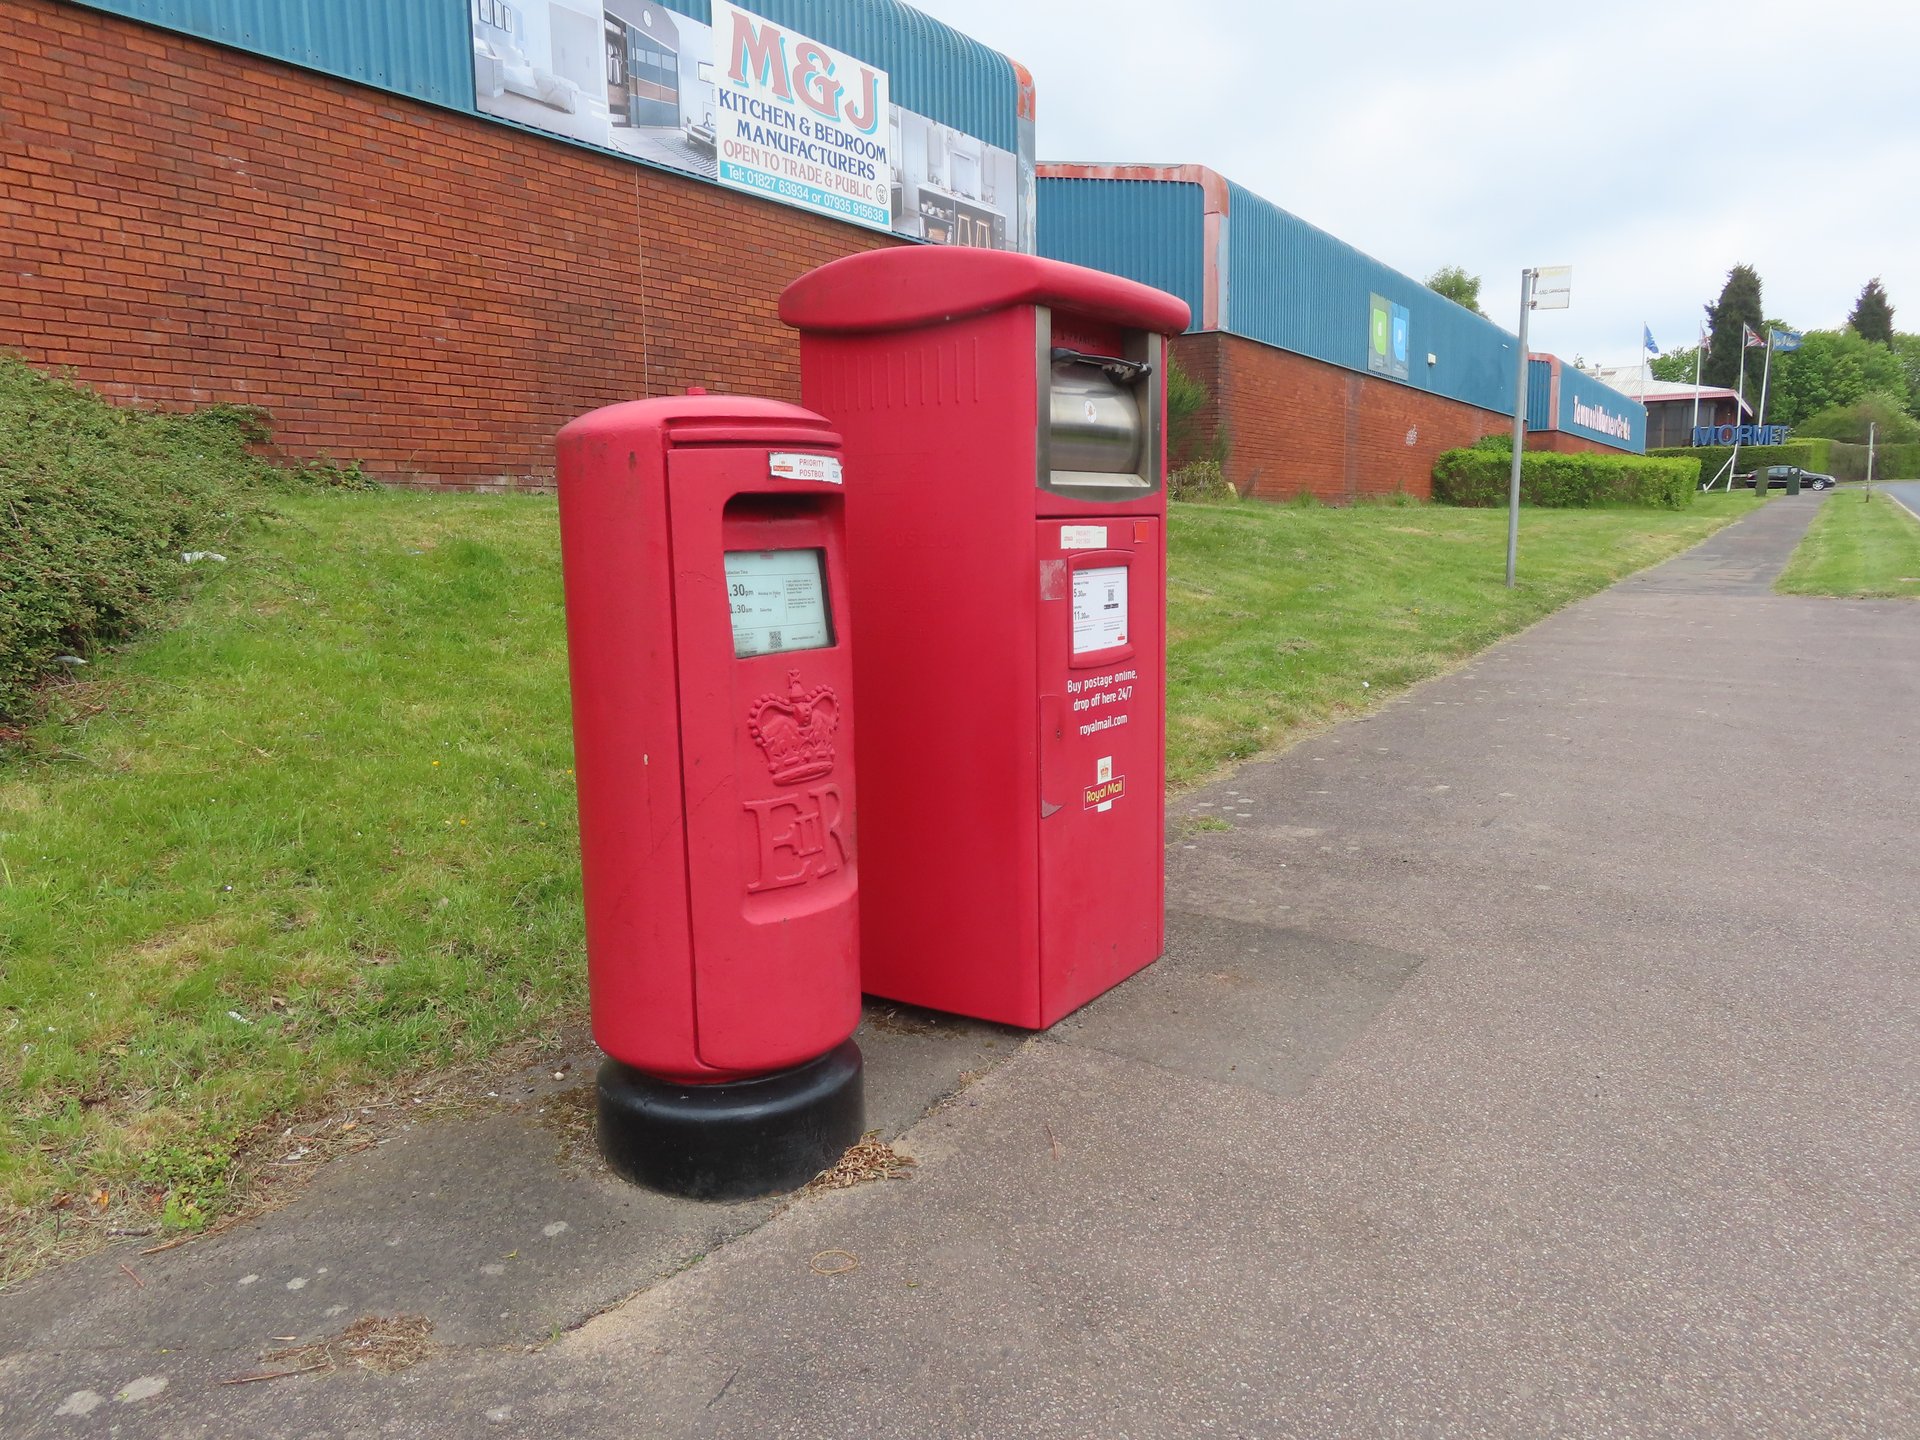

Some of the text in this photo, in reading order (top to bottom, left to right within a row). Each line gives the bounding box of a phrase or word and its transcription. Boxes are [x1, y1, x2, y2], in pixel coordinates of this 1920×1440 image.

[718, 87, 887, 164] KITCHEN & BEDROOM
[736, 118, 876, 181] MANUFACTURERS
[723, 139, 760, 166] OPEN
[762, 150, 780, 172] TO
[782, 156, 823, 185] TRADE
[824, 171, 833, 188] &
[835, 174, 873, 200] PUBLIC
[727, 163, 884, 223] Tel: 01827 63934 or 07935 915638
[1692, 424, 1788, 447] MORMET
[799, 458, 825, 468] PRIORITY
[799, 469, 825, 478] POSTBOX
[1067, 669, 1138, 694] Buy postage online,
[1073, 685, 1133, 712] drop off here 24/7
[1079, 714, 1128, 736] royalmail.com
[1086, 779, 1123, 803] Royal Mail
